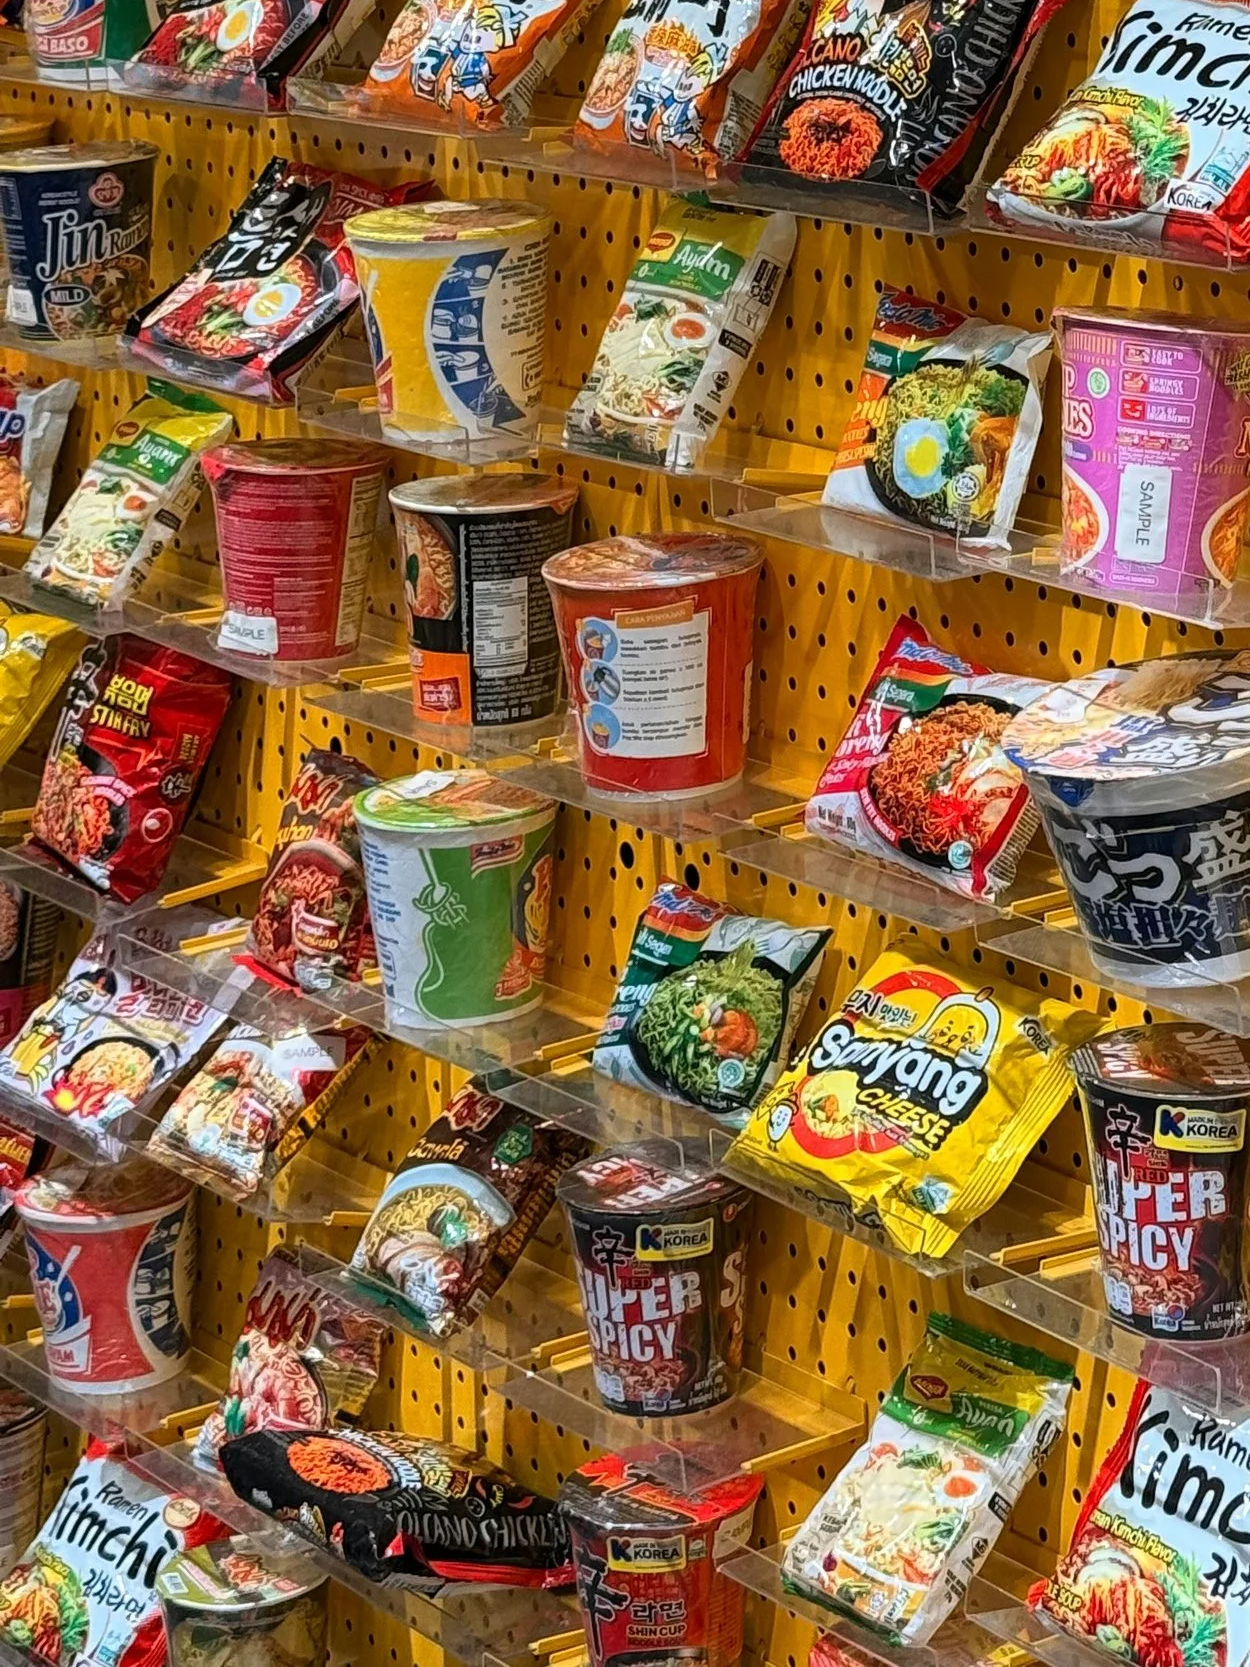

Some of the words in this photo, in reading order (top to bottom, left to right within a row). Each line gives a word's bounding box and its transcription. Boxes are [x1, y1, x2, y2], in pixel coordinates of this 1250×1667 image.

[789, 63, 855, 98] CHICKEN
[37, 208, 108, 282] Jin
[674, 246, 732, 281] Ayam
[49, 287, 84, 305] MILD
[134, 436, 179, 468] Ayam
[1135, 480, 1154, 546] SAMPLE
[1021, 1017, 1051, 1054] KOREA
[814, 1025, 982, 1115] Samyang
[860, 1089, 950, 1147] CHEESE
[1186, 1124, 1238, 1138] KOREA
[1107, 1104, 1151, 1178] 辛
[1135, 1168, 1168, 1183] RED
[592, 1225, 636, 1289] 辛
[664, 1234, 707, 1246] KOREA
[1098, 1211, 1195, 1271] SPICY
[588, 1316, 677, 1362] SPICY
[95, 1480, 149, 1520] Ramen
[633, 1547, 681, 1560] KOREA
[1112, 1514, 1146, 1549] Kimchi
[1146, 1530, 1177, 1564] Flavor
[82, 1564, 146, 1618] 김치라면
[1059, 1588, 1082, 1611] SOUP
[631, 1599, 686, 1624] 라면
[628, 1625, 658, 1637] SHIN
[659, 1624, 686, 1636] CUP
